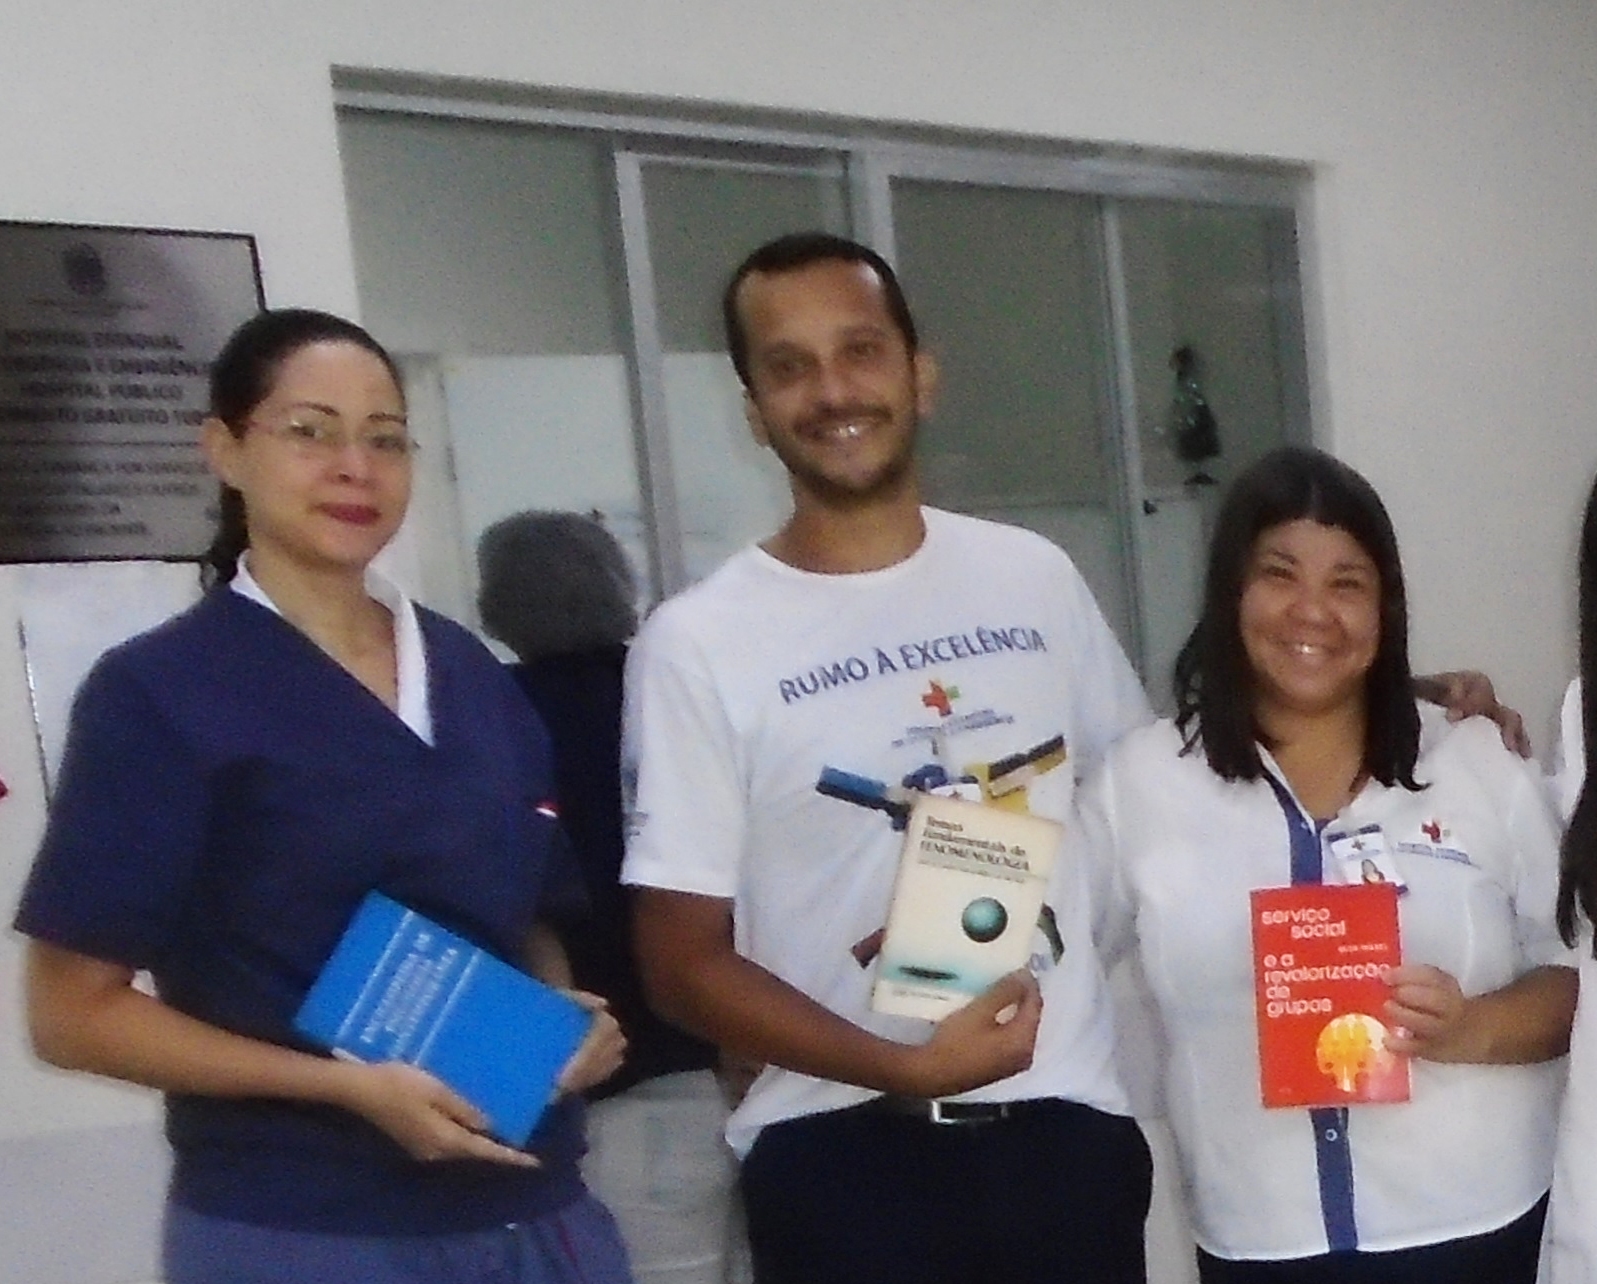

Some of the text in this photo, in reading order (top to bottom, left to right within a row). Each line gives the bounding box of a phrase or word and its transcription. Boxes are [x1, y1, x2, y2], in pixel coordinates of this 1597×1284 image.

[779, 625, 1047, 704] RUMO À EXCELÊNCIA
[1261, 908, 1330, 925] serviço
[1290, 920, 1346, 939] social
[1263, 953, 1294, 968] e a
[1267, 998, 1332, 1018] grupos
